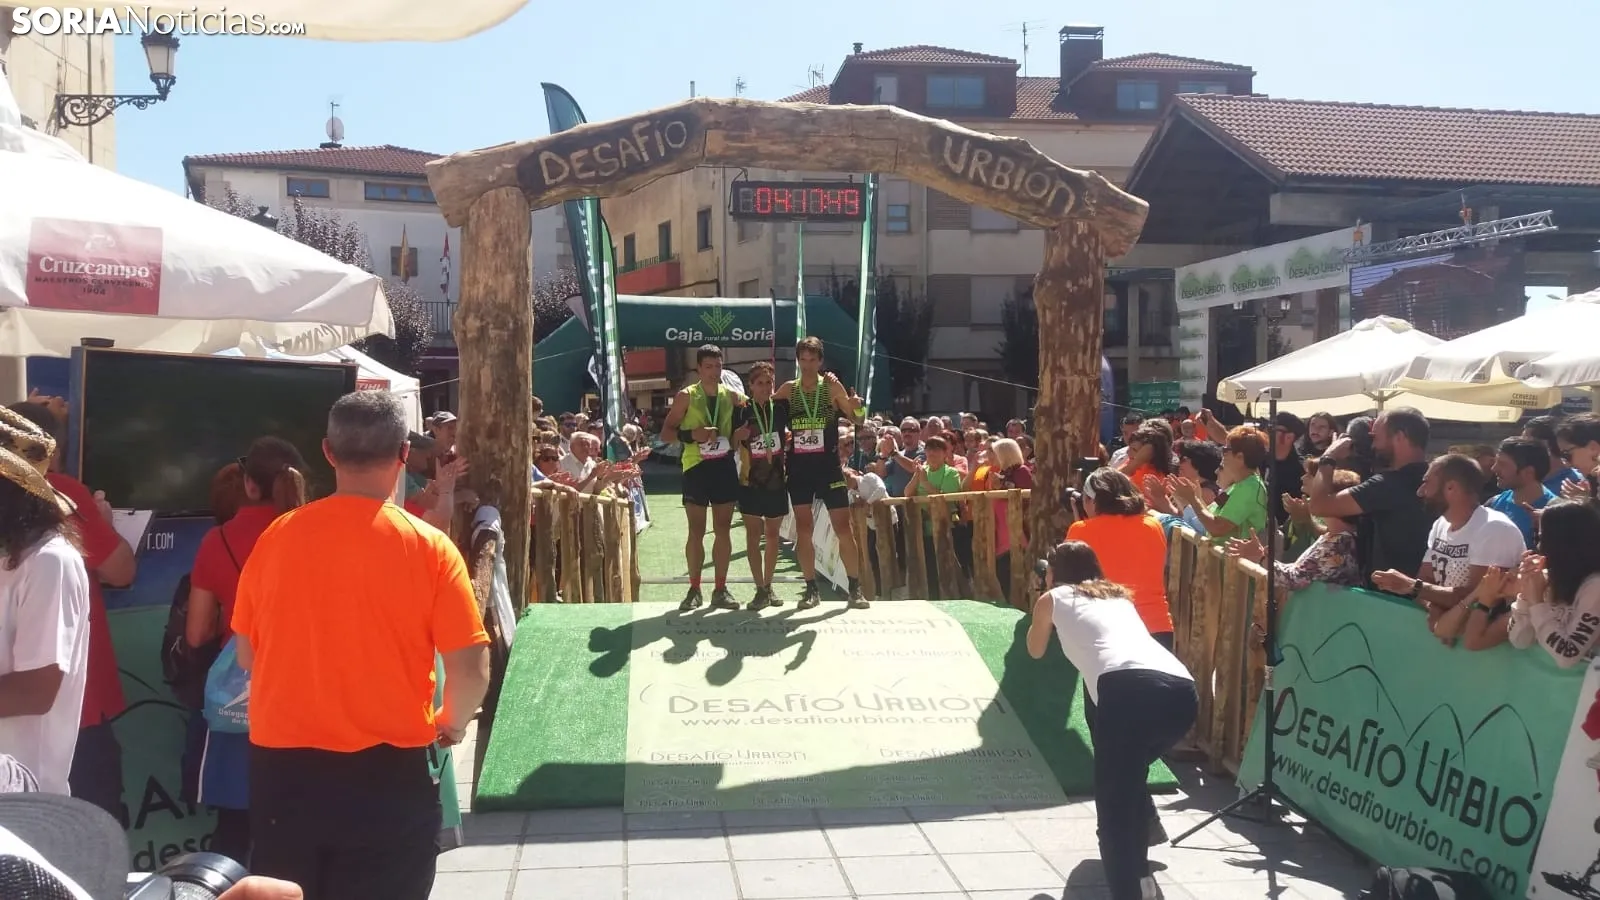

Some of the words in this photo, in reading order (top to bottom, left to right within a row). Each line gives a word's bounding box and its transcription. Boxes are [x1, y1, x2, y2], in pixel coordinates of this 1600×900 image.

[39, 255, 150, 279] Cruzcampo
[34, 276, 88, 284] MAESTROS
[665, 327, 703, 343] Caja
[731, 327, 774, 341] Soria
[681, 714, 978, 727] www.desafiourbion.com
[1415, 740, 1546, 873] URBIÓ
[1271, 751, 1519, 895] www.desafiourbion.com
